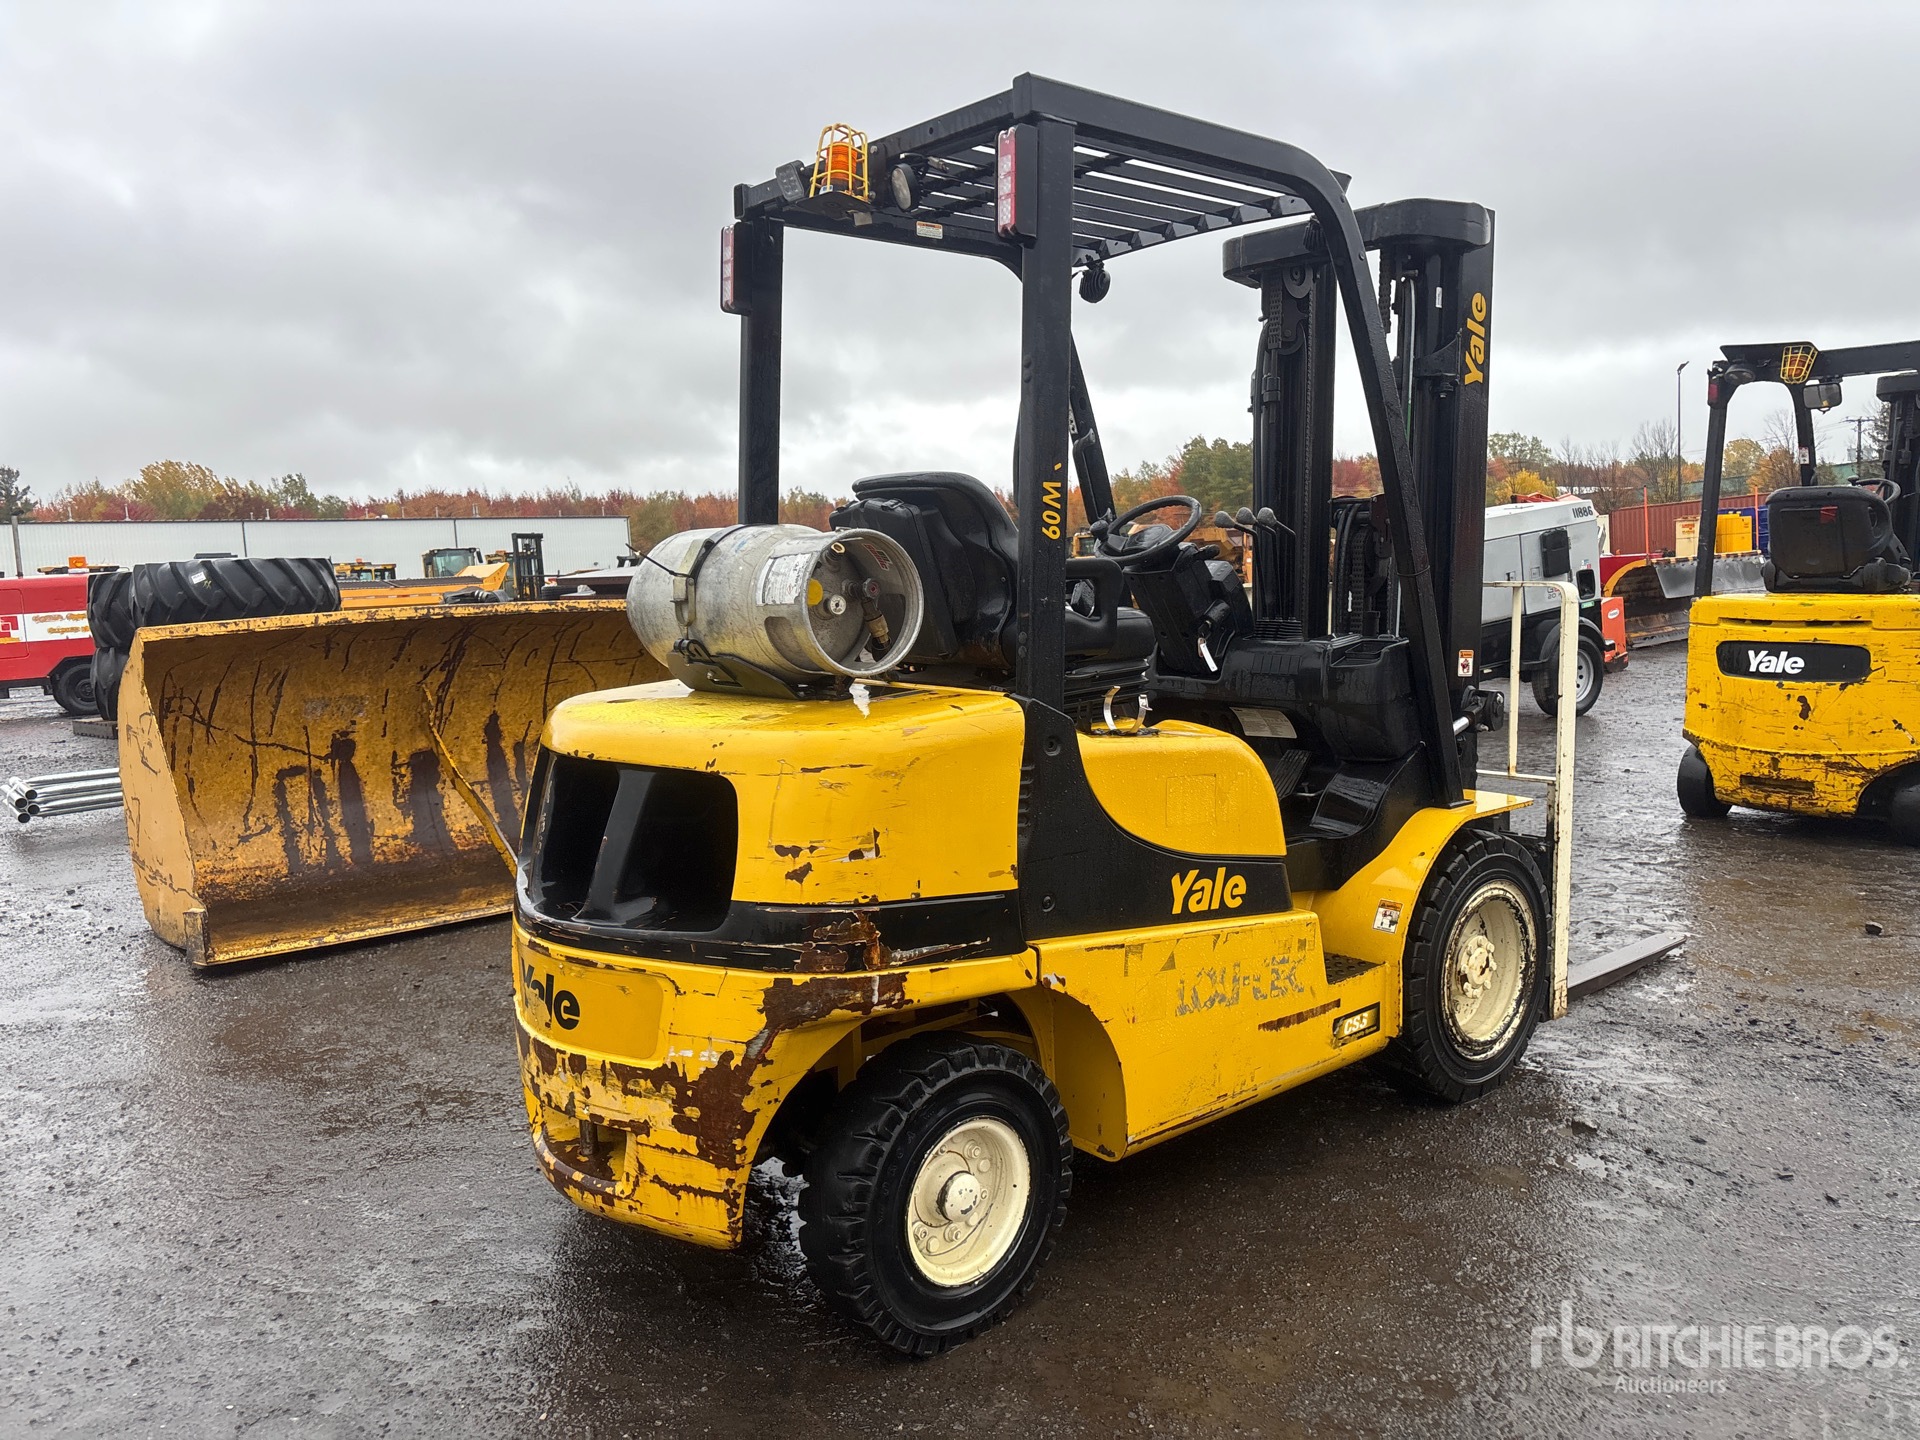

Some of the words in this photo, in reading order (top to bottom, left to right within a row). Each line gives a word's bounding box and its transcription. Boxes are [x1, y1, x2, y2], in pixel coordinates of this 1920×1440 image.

[1464, 292, 1487, 385] Yale
[1744, 650, 1805, 675] Yale
[1171, 867, 1247, 915] Yale
[521, 957, 581, 1031] Yale
